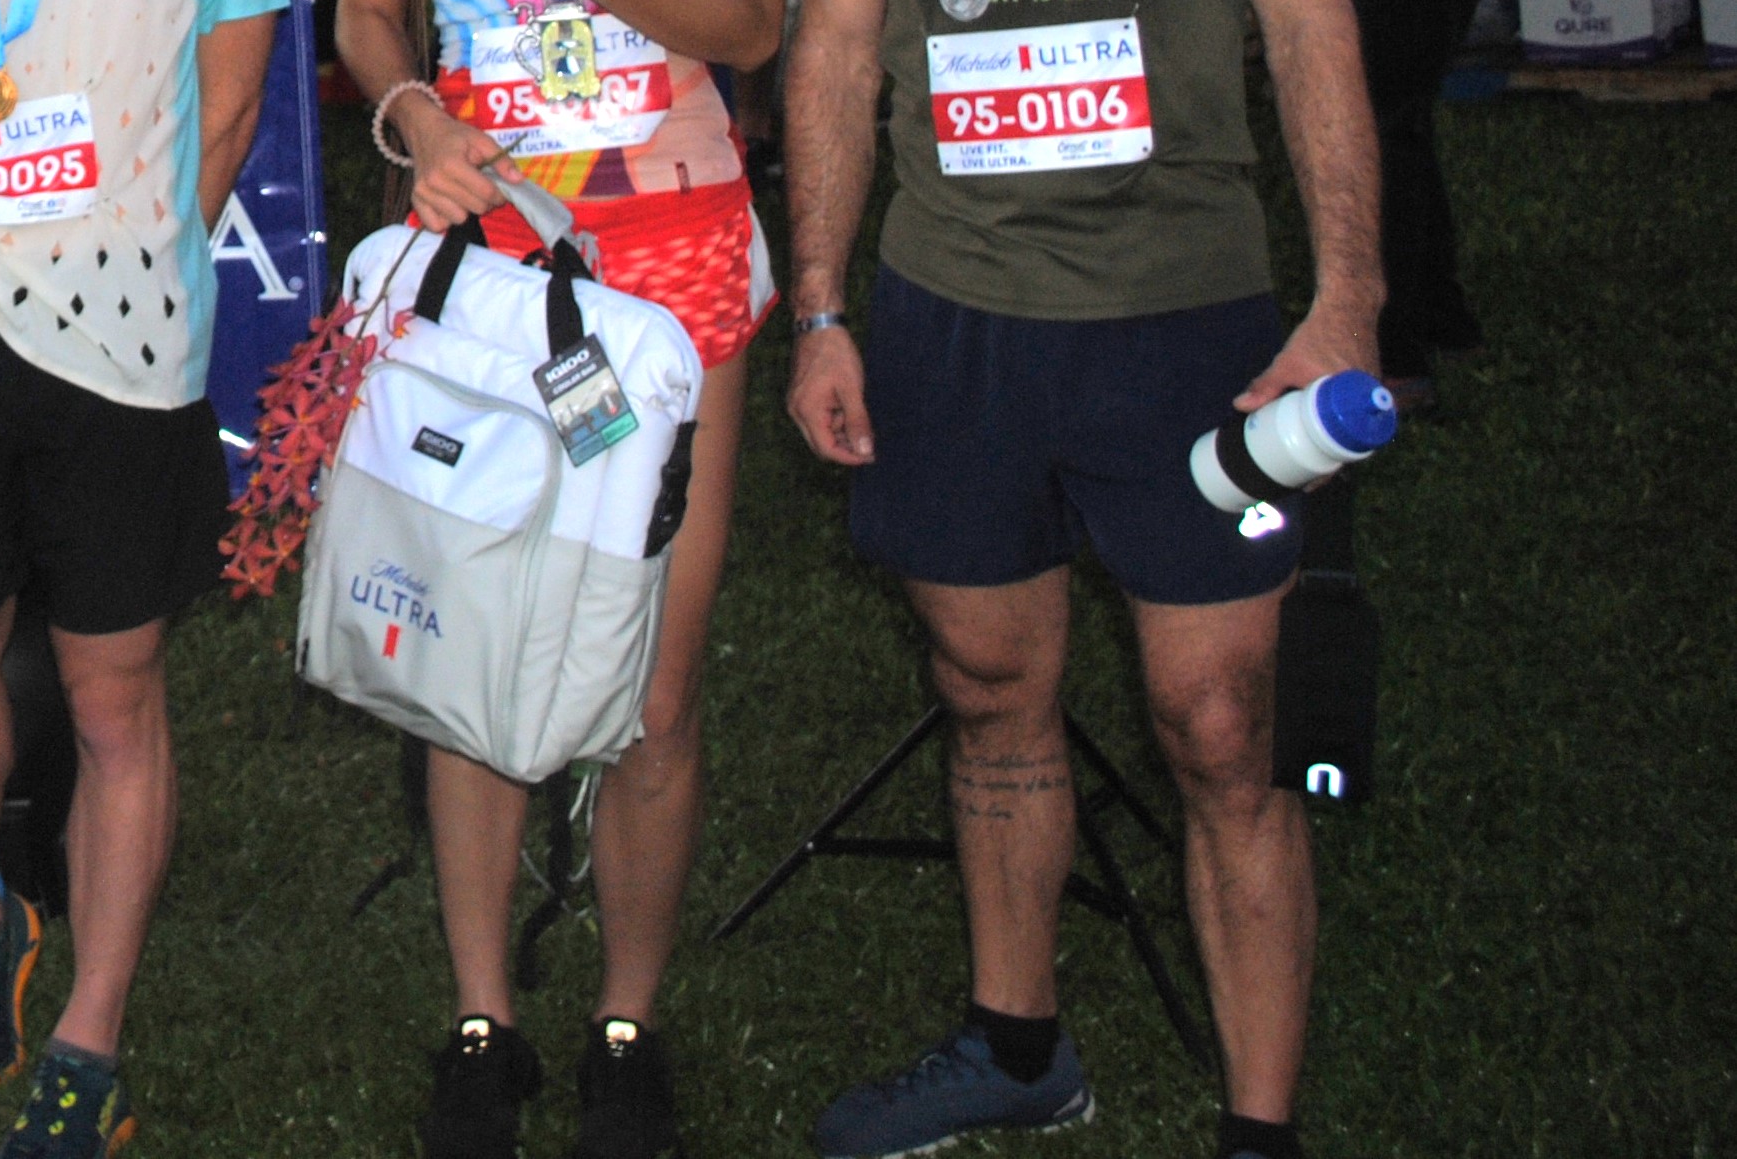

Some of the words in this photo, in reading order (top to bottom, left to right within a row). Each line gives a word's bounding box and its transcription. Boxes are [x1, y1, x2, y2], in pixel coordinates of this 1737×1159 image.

[592, 30, 651, 52] LTR
[934, 49, 1013, 76] Michelob
[1039, 39, 1133, 67] ULTRA
[487, 71, 651, 125] 9507
[947, 85, 1128, 137] 95-0106
[6, 109, 86, 140] ULTRA
[351, 575, 442, 638] ULTRA
